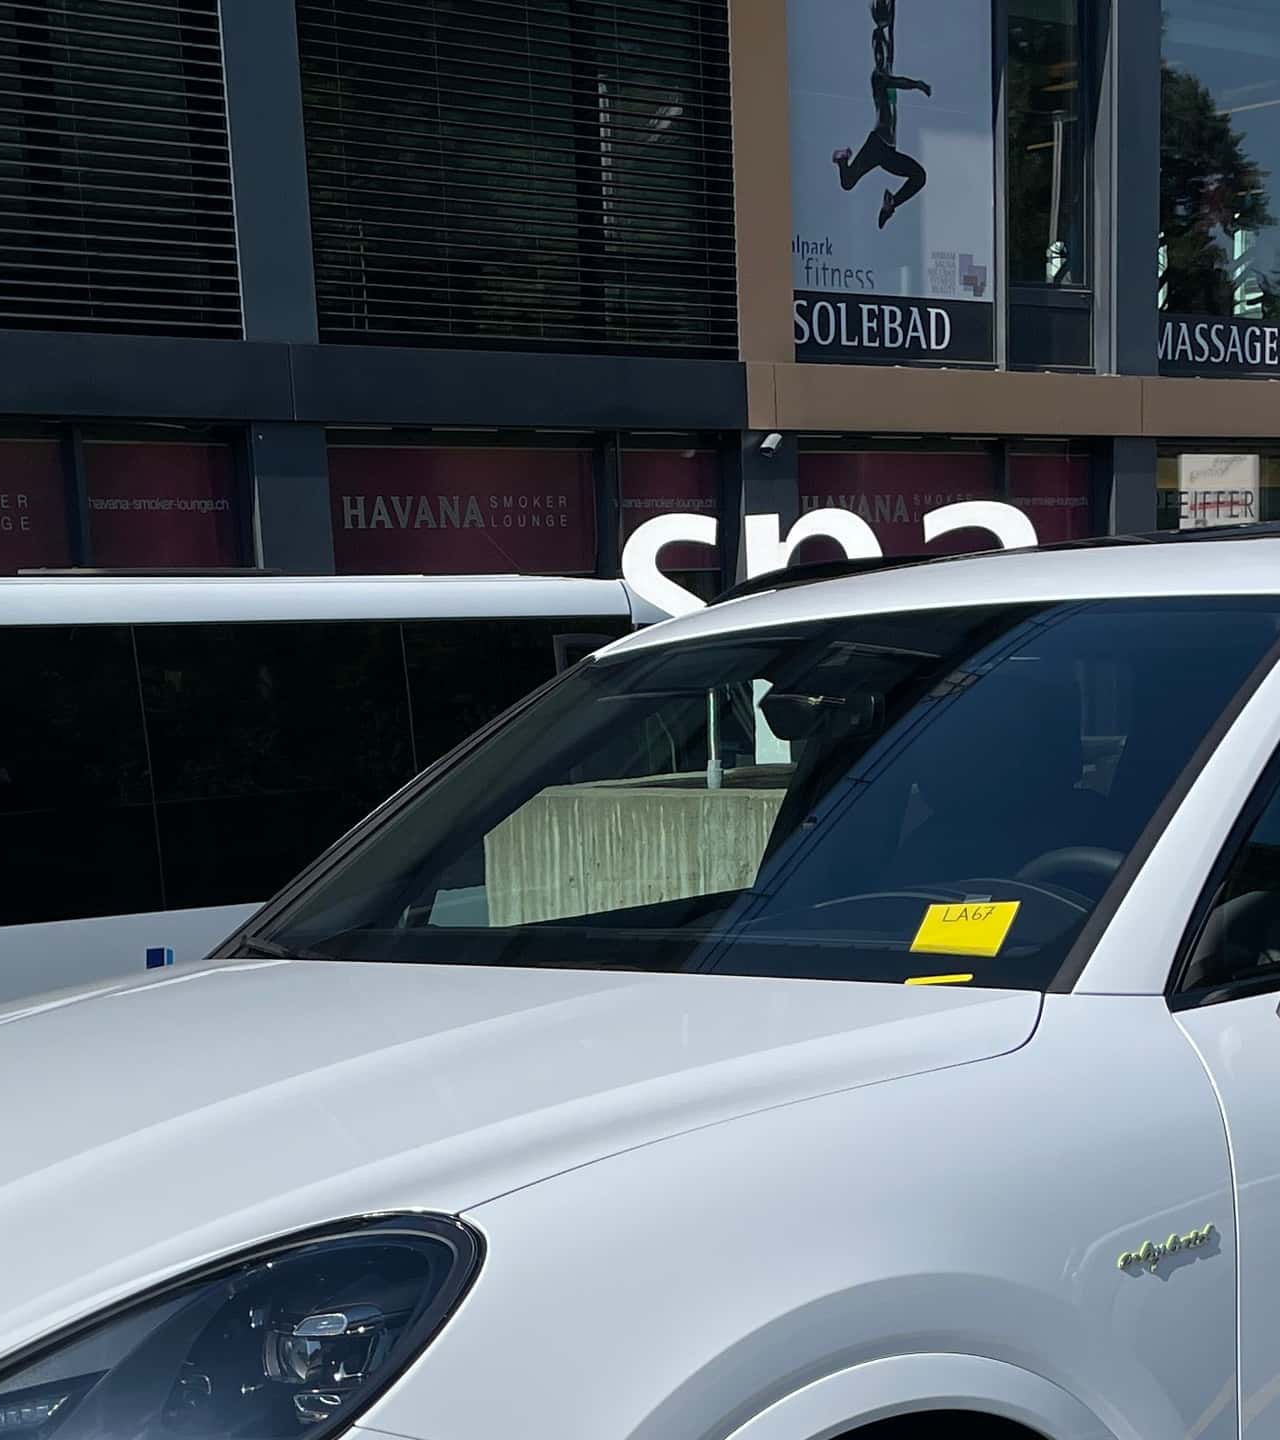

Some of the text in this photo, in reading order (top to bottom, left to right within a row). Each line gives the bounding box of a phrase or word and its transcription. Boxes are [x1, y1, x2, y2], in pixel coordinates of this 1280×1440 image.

[804, 257, 875, 290] fitness
[793, 299, 951, 350] SOLEBAD
[88, 494, 231, 515] havana-smoker-lounge.ch
[342, 495, 570, 530] HAVANA SMOKER
[490, 514, 569, 528] LOUNGE
[942, 905, 995, 923] LA67
